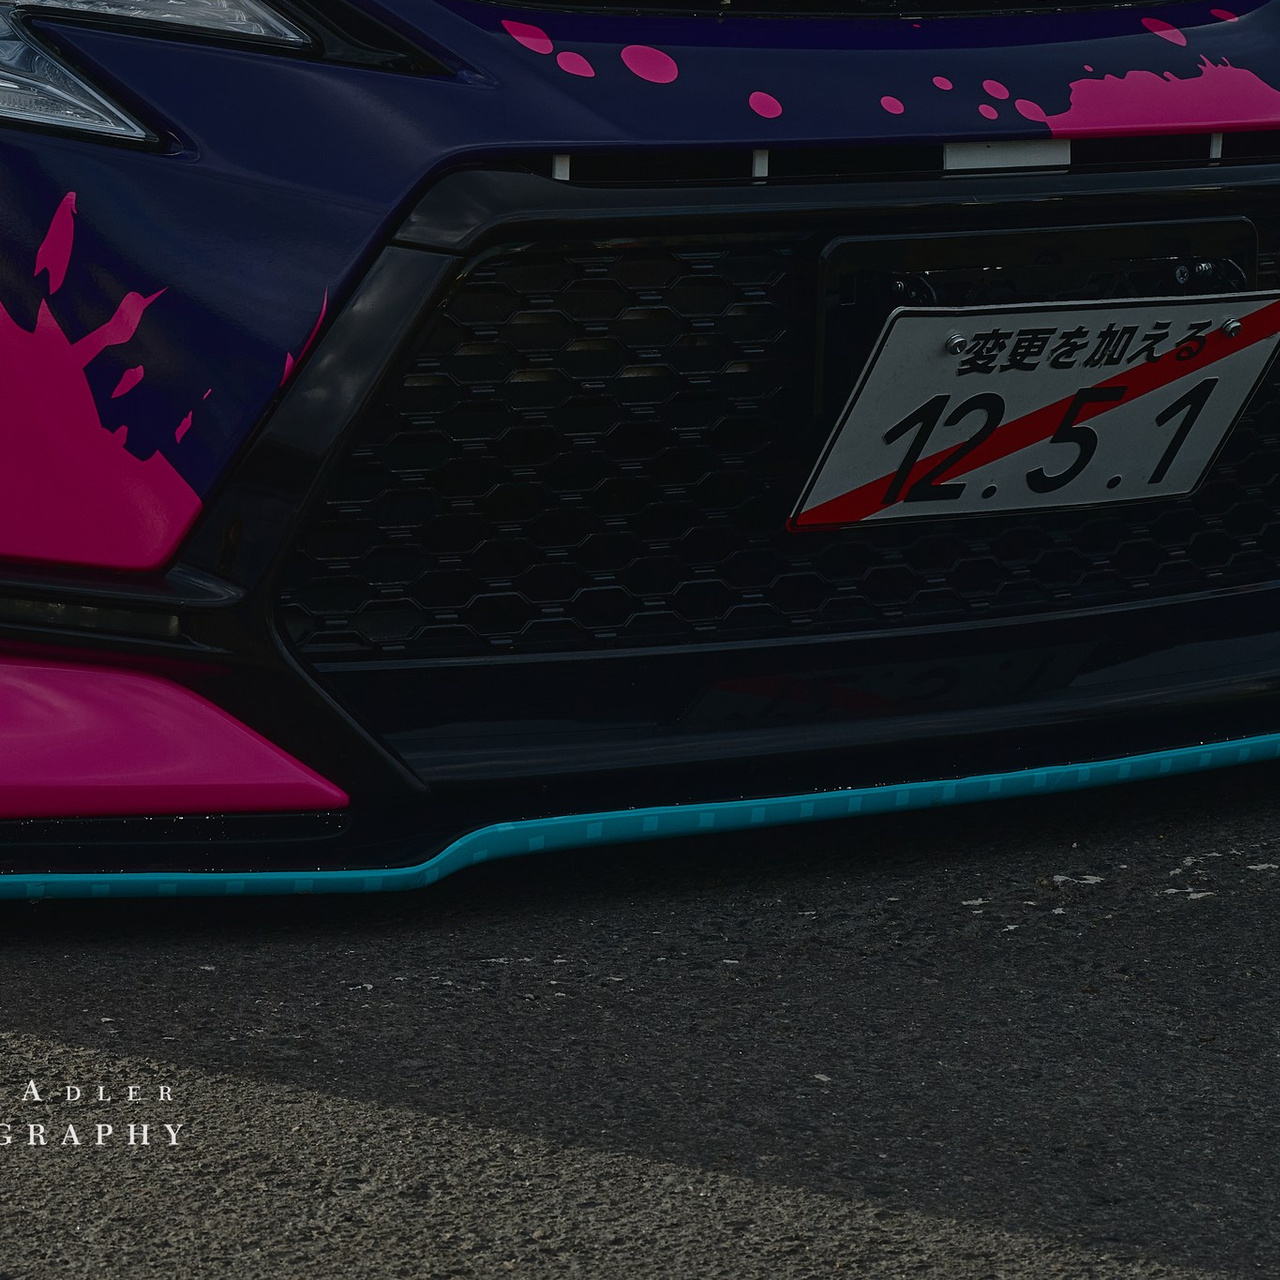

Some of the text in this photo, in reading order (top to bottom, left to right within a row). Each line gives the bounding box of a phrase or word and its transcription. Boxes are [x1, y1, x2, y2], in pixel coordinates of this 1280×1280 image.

[957, 320, 1213, 376] 変更を加える
[881, 377, 1220, 505] 12.5.1
